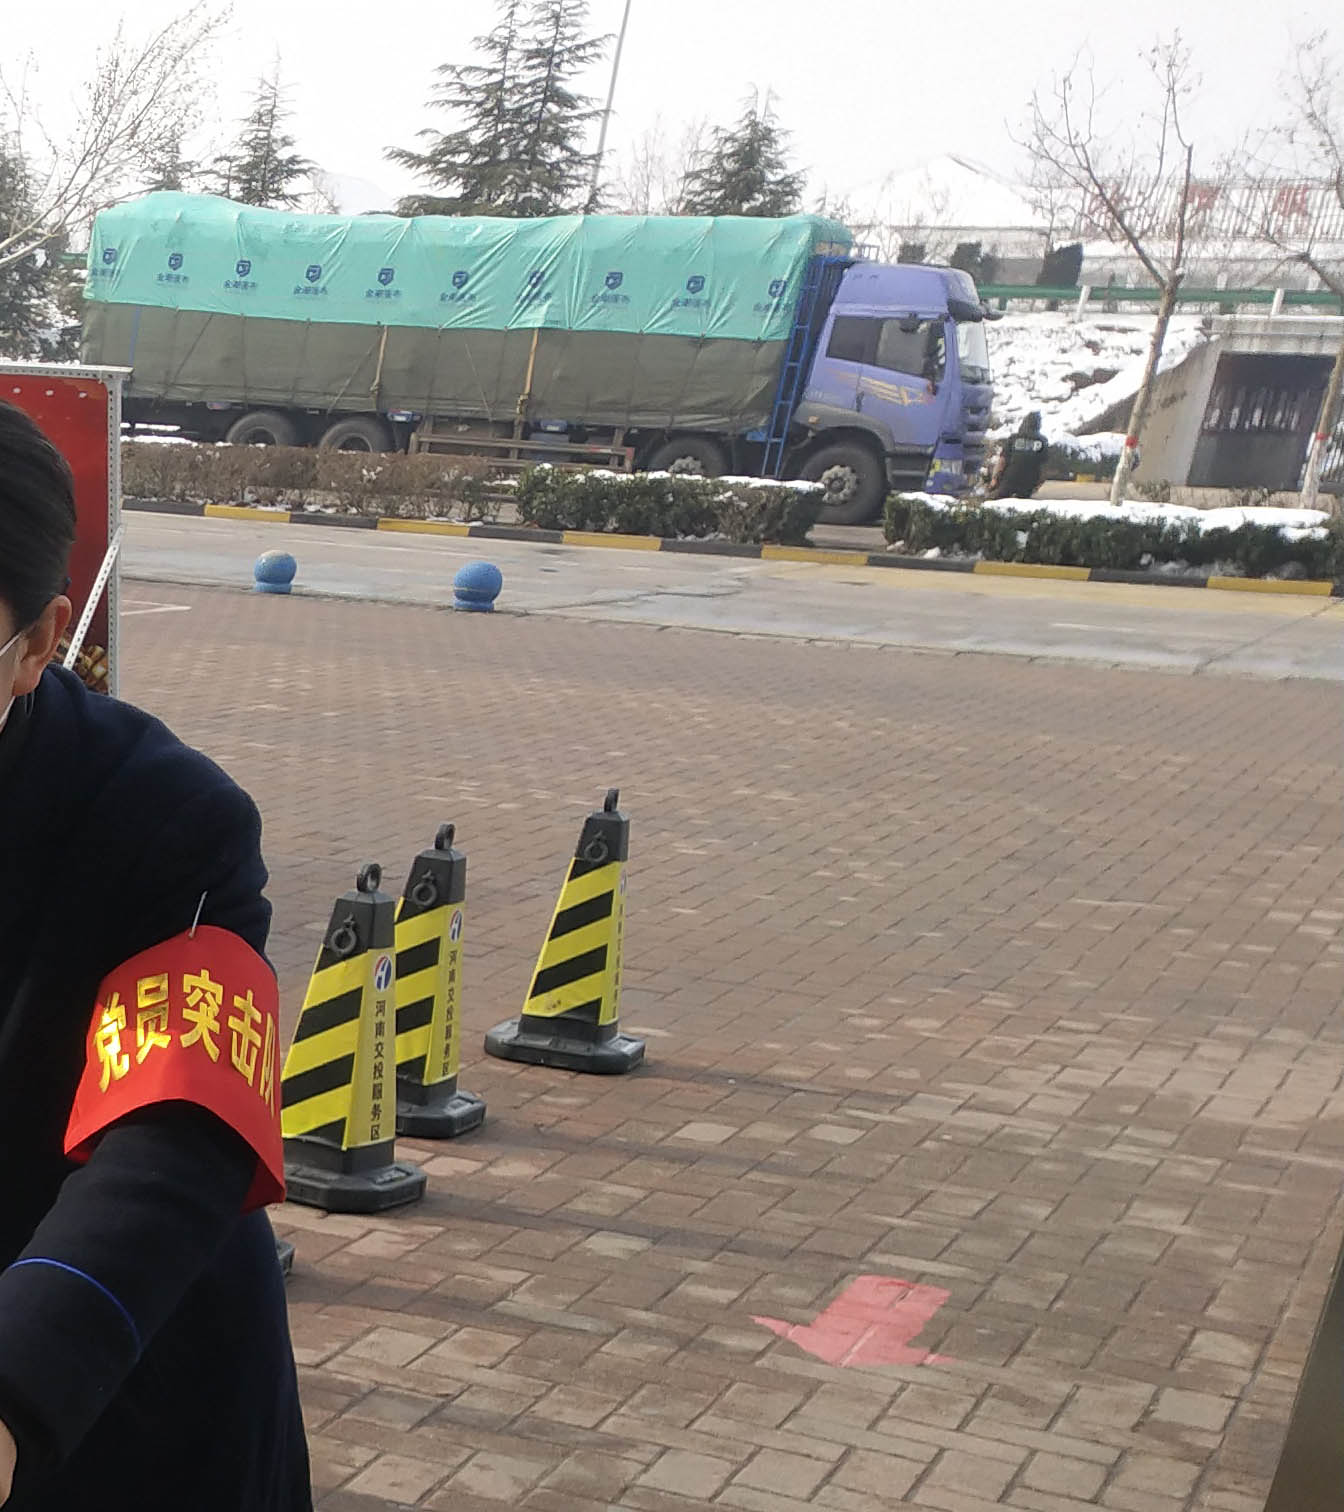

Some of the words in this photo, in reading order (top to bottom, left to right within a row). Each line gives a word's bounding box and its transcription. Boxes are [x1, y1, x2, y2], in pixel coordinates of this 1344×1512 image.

[95, 968, 276, 1120] 党员突击队
[369, 1000, 386, 1142] 河南交投服务区
